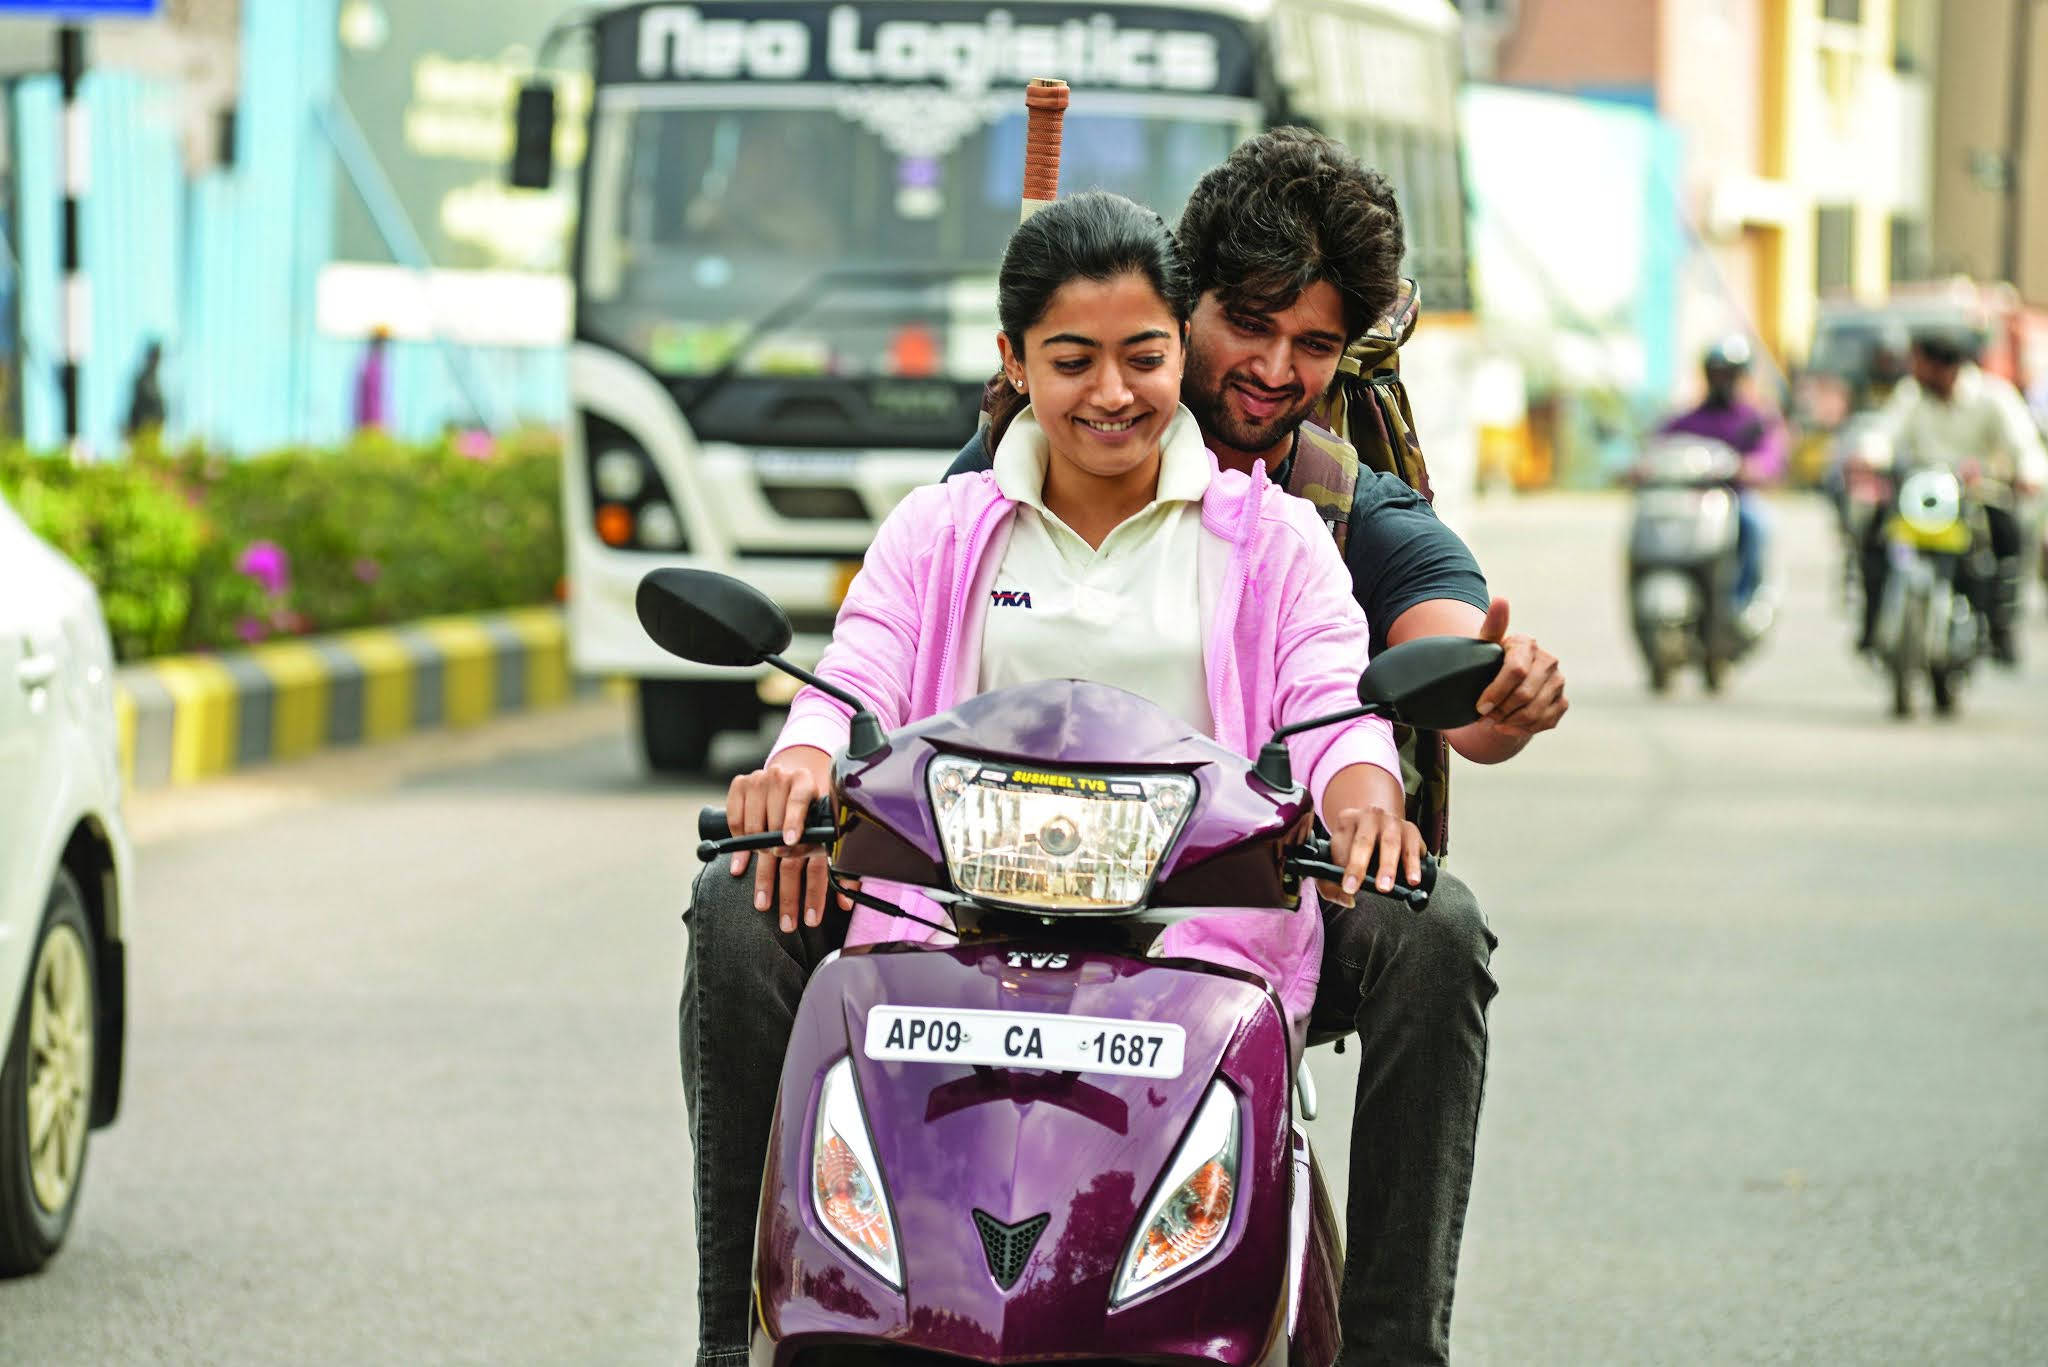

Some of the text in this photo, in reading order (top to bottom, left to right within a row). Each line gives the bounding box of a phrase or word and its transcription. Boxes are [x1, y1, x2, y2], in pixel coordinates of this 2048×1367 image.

[636, 6, 1220, 98] Neo Logistics
[1012, 770, 1075, 789] SUSHEEL
[1077, 778, 1107, 792] TVS
[1007, 951, 1069, 969] TVS
[885, 1018, 1164, 1067] AP09 CA 1687
